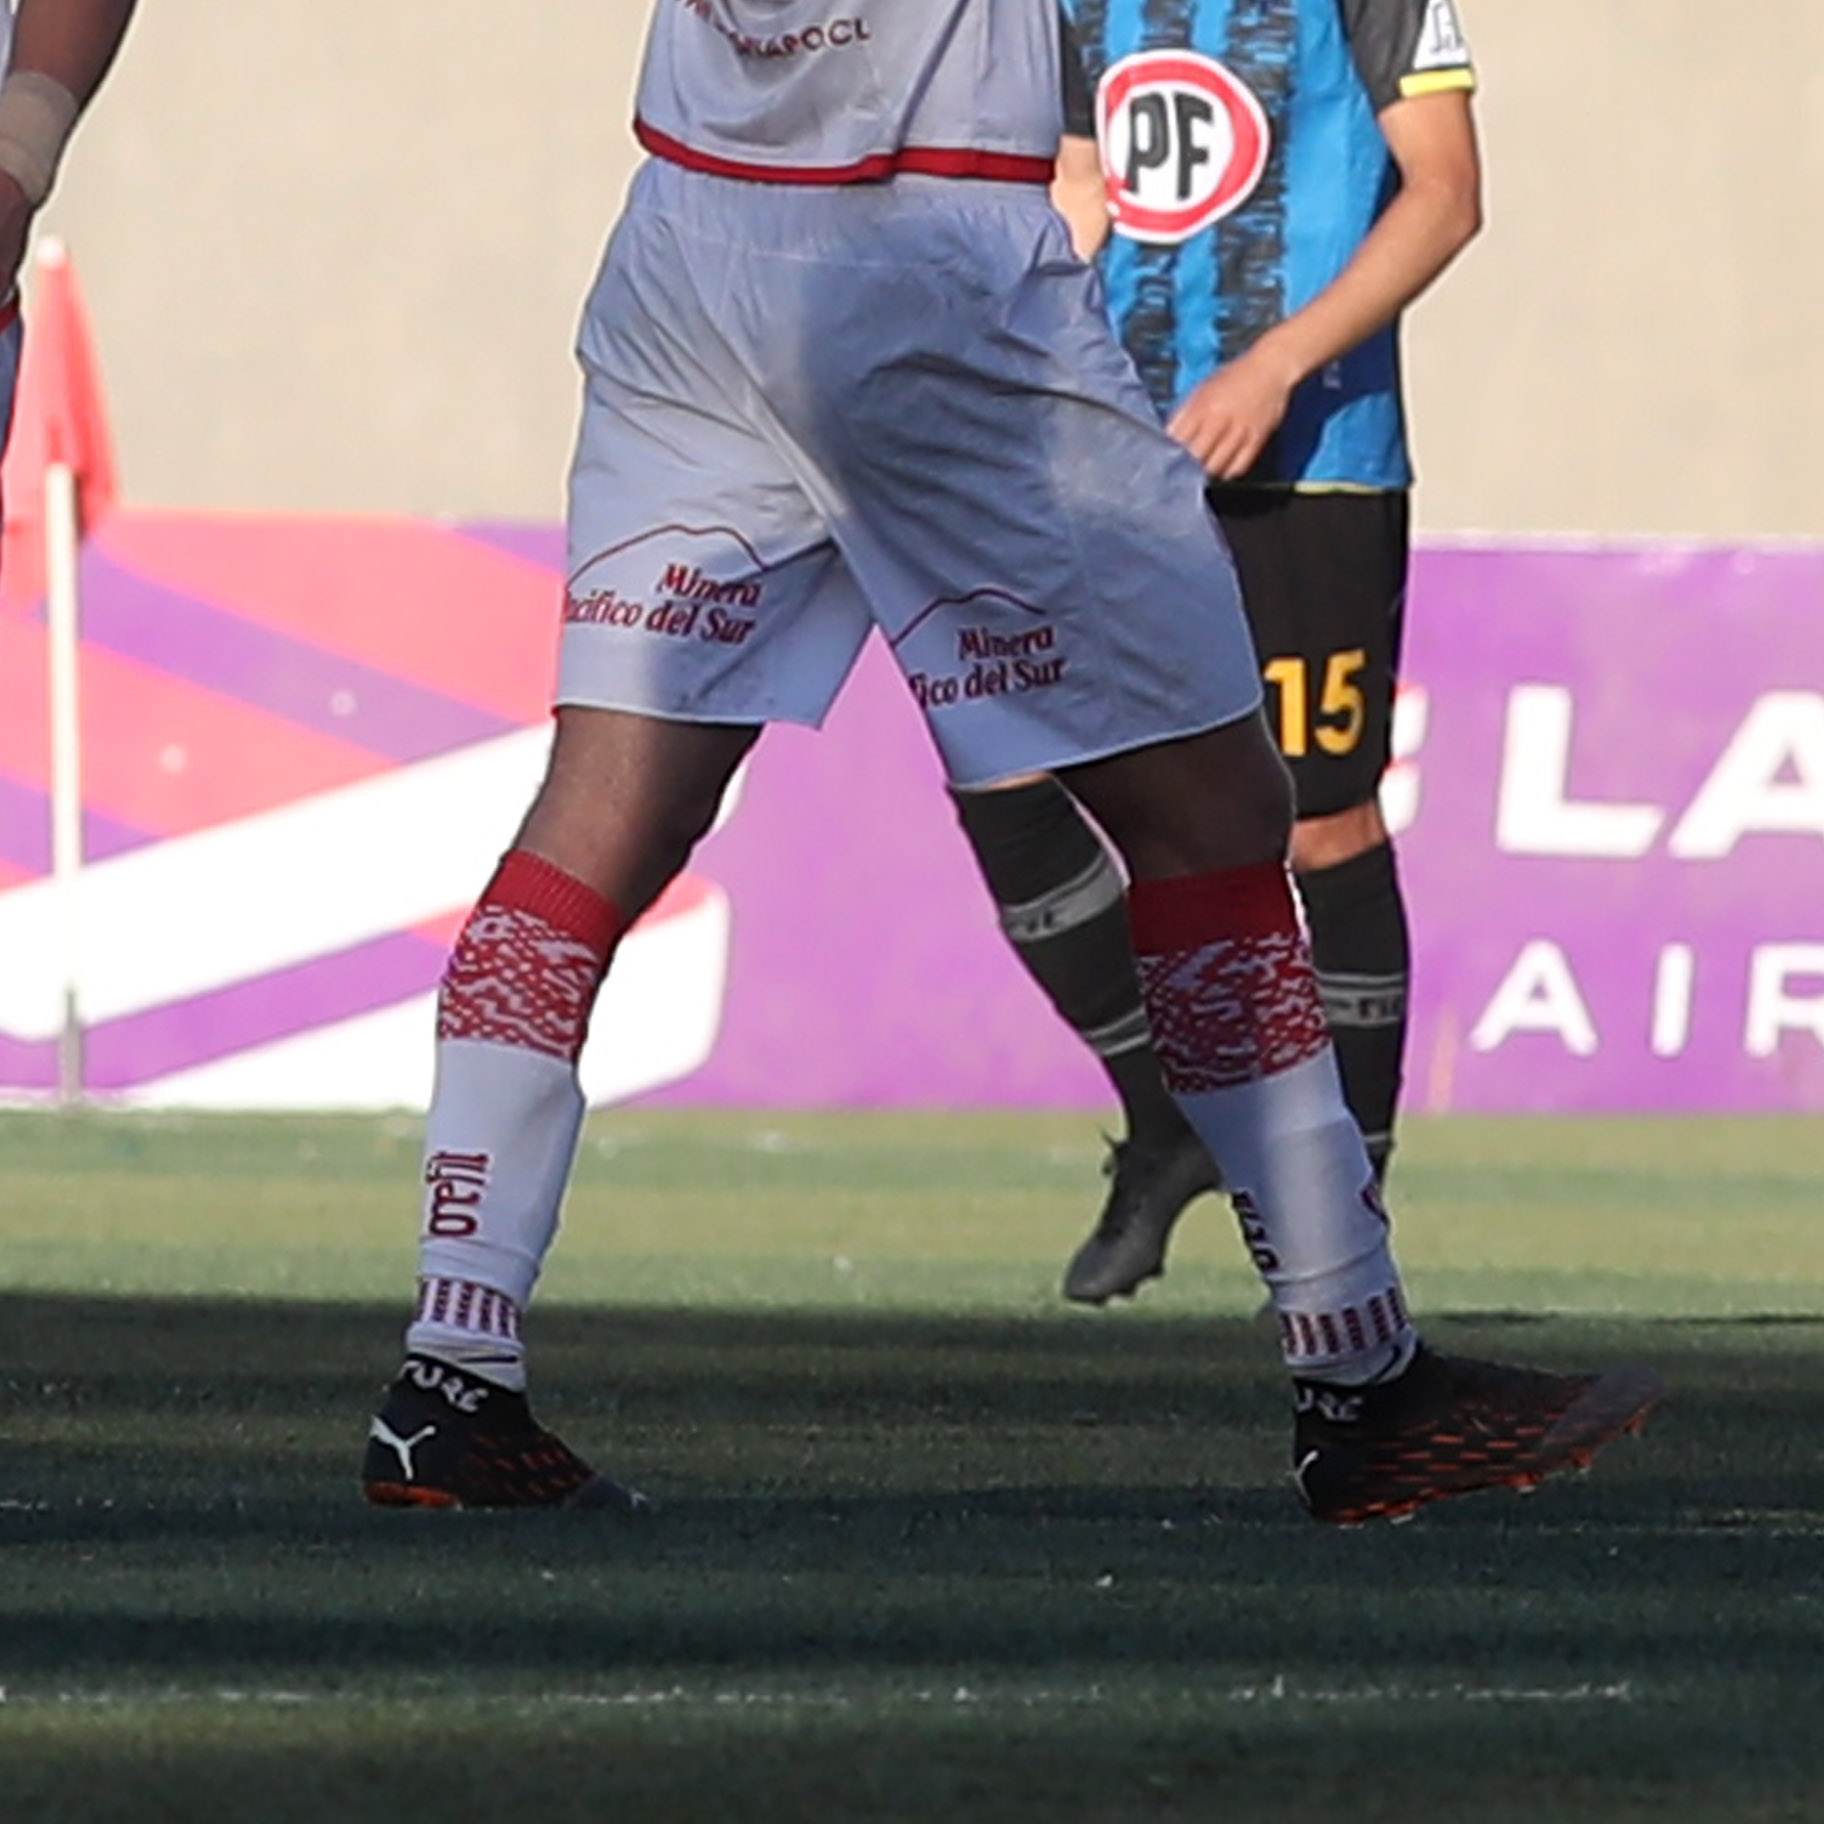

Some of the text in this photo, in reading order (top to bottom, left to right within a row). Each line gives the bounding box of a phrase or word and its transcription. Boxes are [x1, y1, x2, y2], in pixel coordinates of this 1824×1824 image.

[1126, 91, 1214, 201] PF
[655, 562, 762, 608] Minera
[645, 599, 701, 637] del
[700, 606, 756, 646] Sur
[957, 626, 1055, 661] Minera
[964, 660, 1009, 700] del
[1012, 656, 1068, 692] Sur
[1263, 649, 1366, 757] 15
